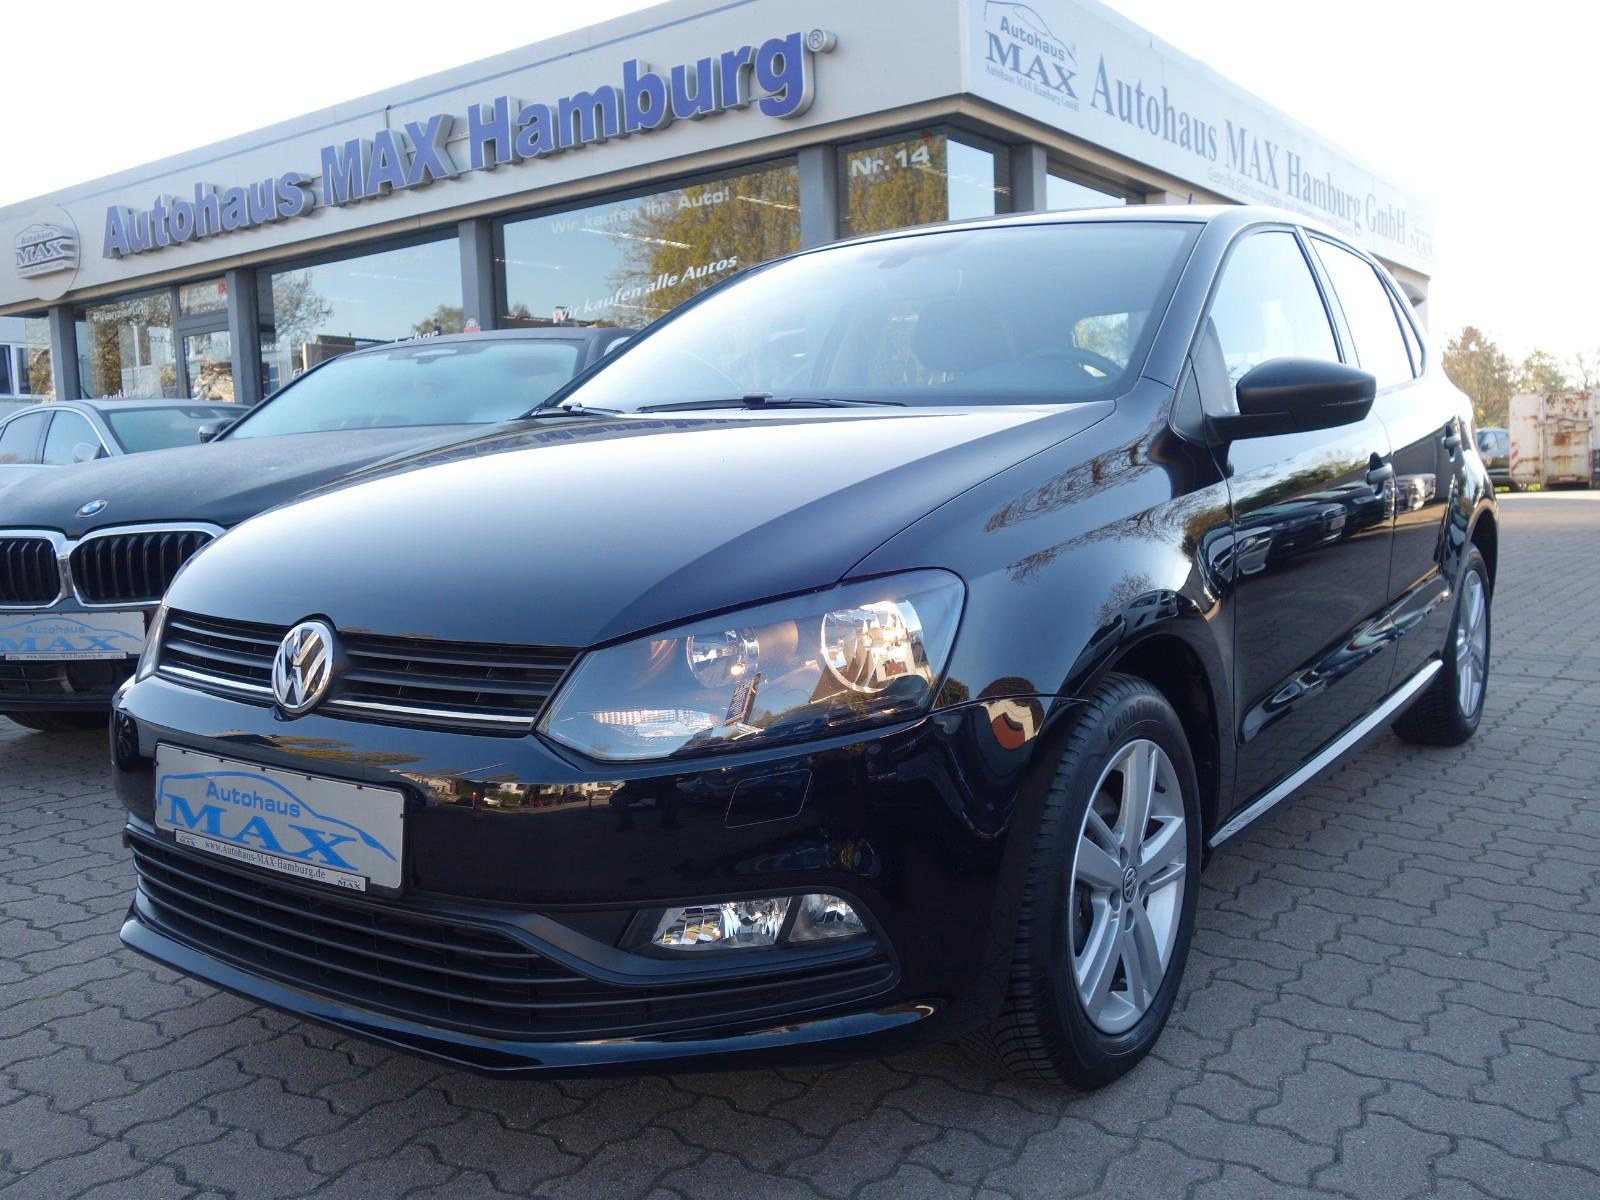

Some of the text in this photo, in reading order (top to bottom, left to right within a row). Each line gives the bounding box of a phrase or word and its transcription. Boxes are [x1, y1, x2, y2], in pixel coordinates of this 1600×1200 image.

[1000, 16, 1065, 61] Autohaus
[984, 29, 1079, 99] MAX
[102, 171, 306, 258] Autohaus
[320, 113, 454, 206] MAX
[467, 31, 804, 119] Hamburg
[850, 143, 931, 178] Nr. 14
[1089, 53, 1218, 162] Autohaus
[1224, 119, 1282, 189] MAX
[1286, 145, 1362, 237] Hamburg
[1365, 192, 1407, 245] GmbH
[550, 187, 731, 236] Wir kaufen Ihr Auto!
[16, 240, 64, 265] MAX
[552, 254, 738, 323] Wir kaufen alle Autos
[0, 635, 122, 651] MAX
[25, 625, 86, 634] Autohaus
[206, 781, 301, 818] Autohaus
[164, 793, 359, 872] MAX
[204, 840, 326, 879] www.Autohaus-MAX-Hamburg.de
